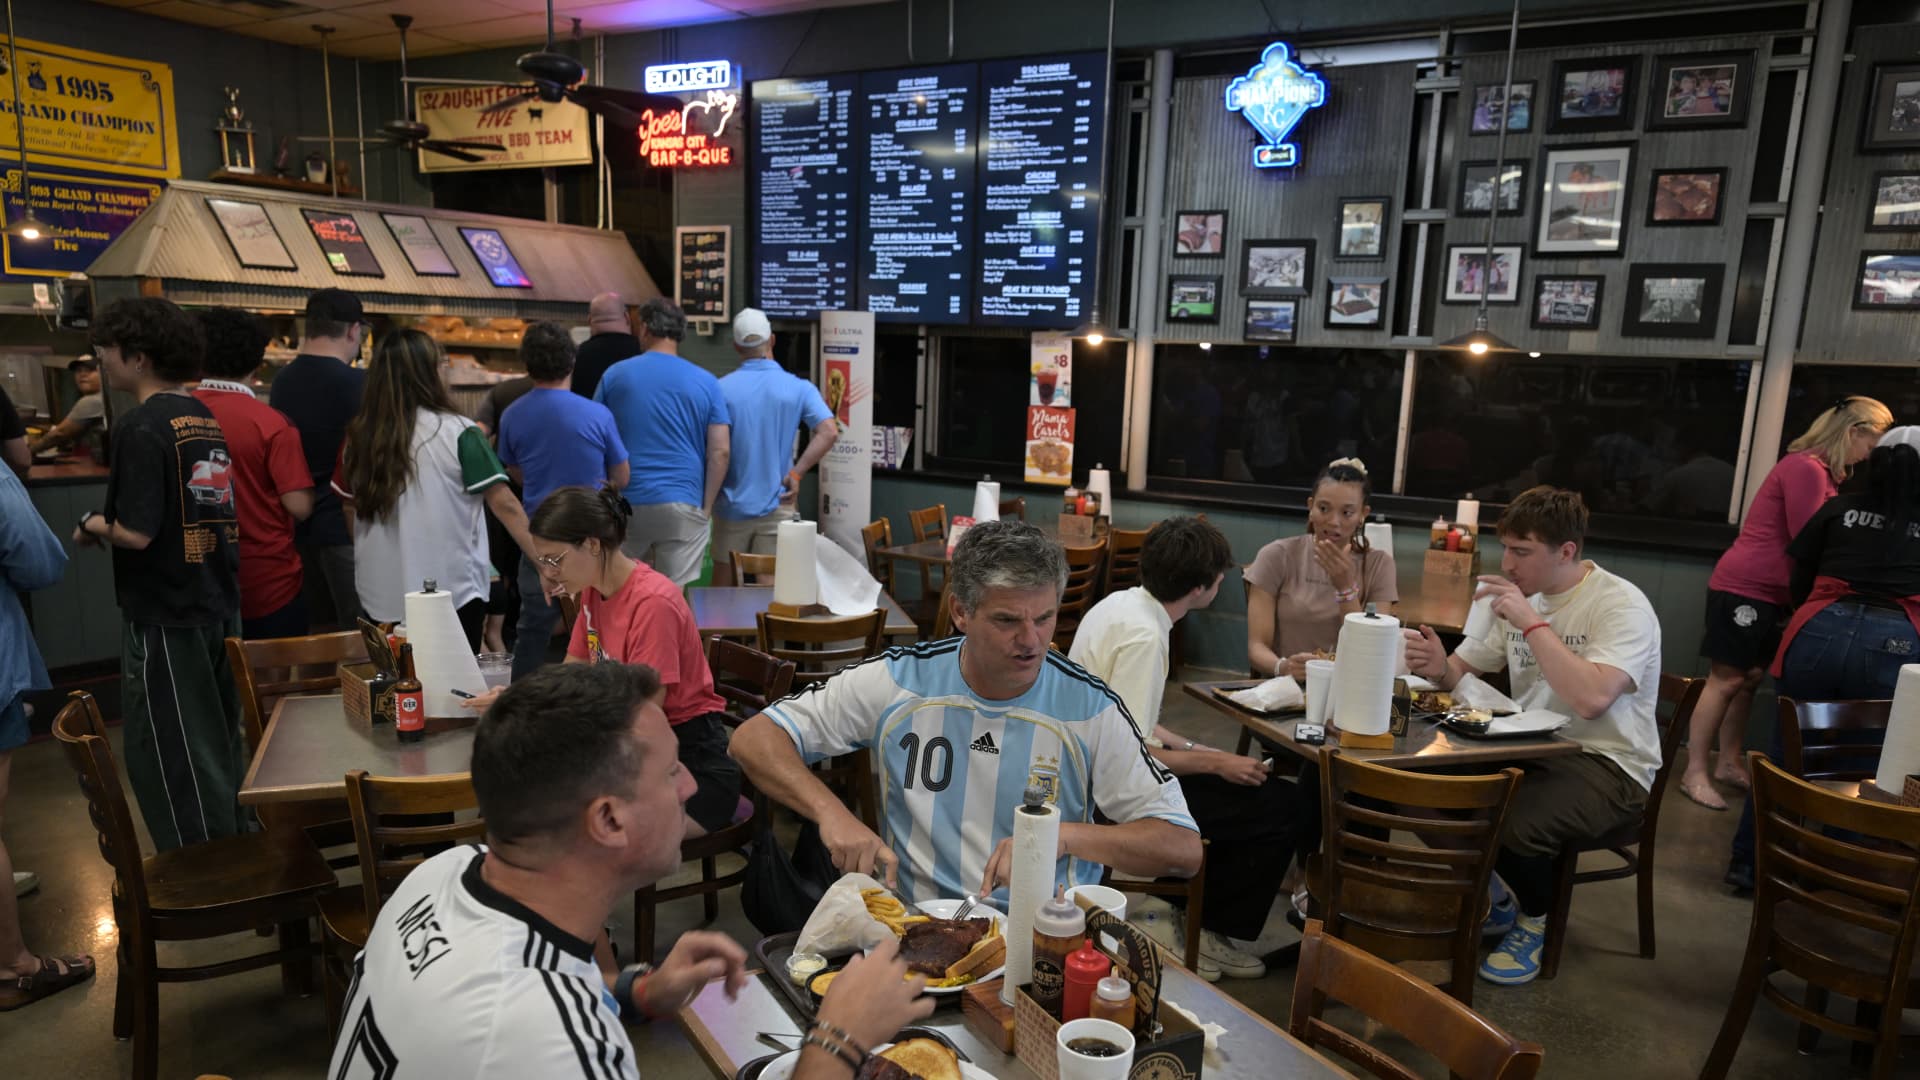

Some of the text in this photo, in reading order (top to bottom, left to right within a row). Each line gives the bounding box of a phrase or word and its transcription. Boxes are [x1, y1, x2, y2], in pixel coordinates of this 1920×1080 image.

[55, 75, 114, 103] 1995
[1232, 79, 1318, 106] CHAMPIONS
[70, 109, 155, 135] CHAMPION
[476, 109, 518, 129] FIVE
[1263, 103, 1285, 128] KC
[509, 134, 531, 147] BBQ
[536, 129, 573, 145] TEAM
[639, 108, 682, 157] Joe's
[650, 147, 730, 167] BAR-B-QUE
[54, 187, 91, 201] GRAND
[95, 191, 149, 207] CHAMPION
[53, 239, 79, 252] Five
[1054, 355, 1068, 368] $8
[1032, 409, 1068, 424] Mama
[1033, 423, 1070, 439] Carol's
[1842, 509, 1884, 529] QUE
[969, 743, 1000, 755] adidas
[898, 731, 954, 793] 10
[396, 894, 452, 980] MESSI
